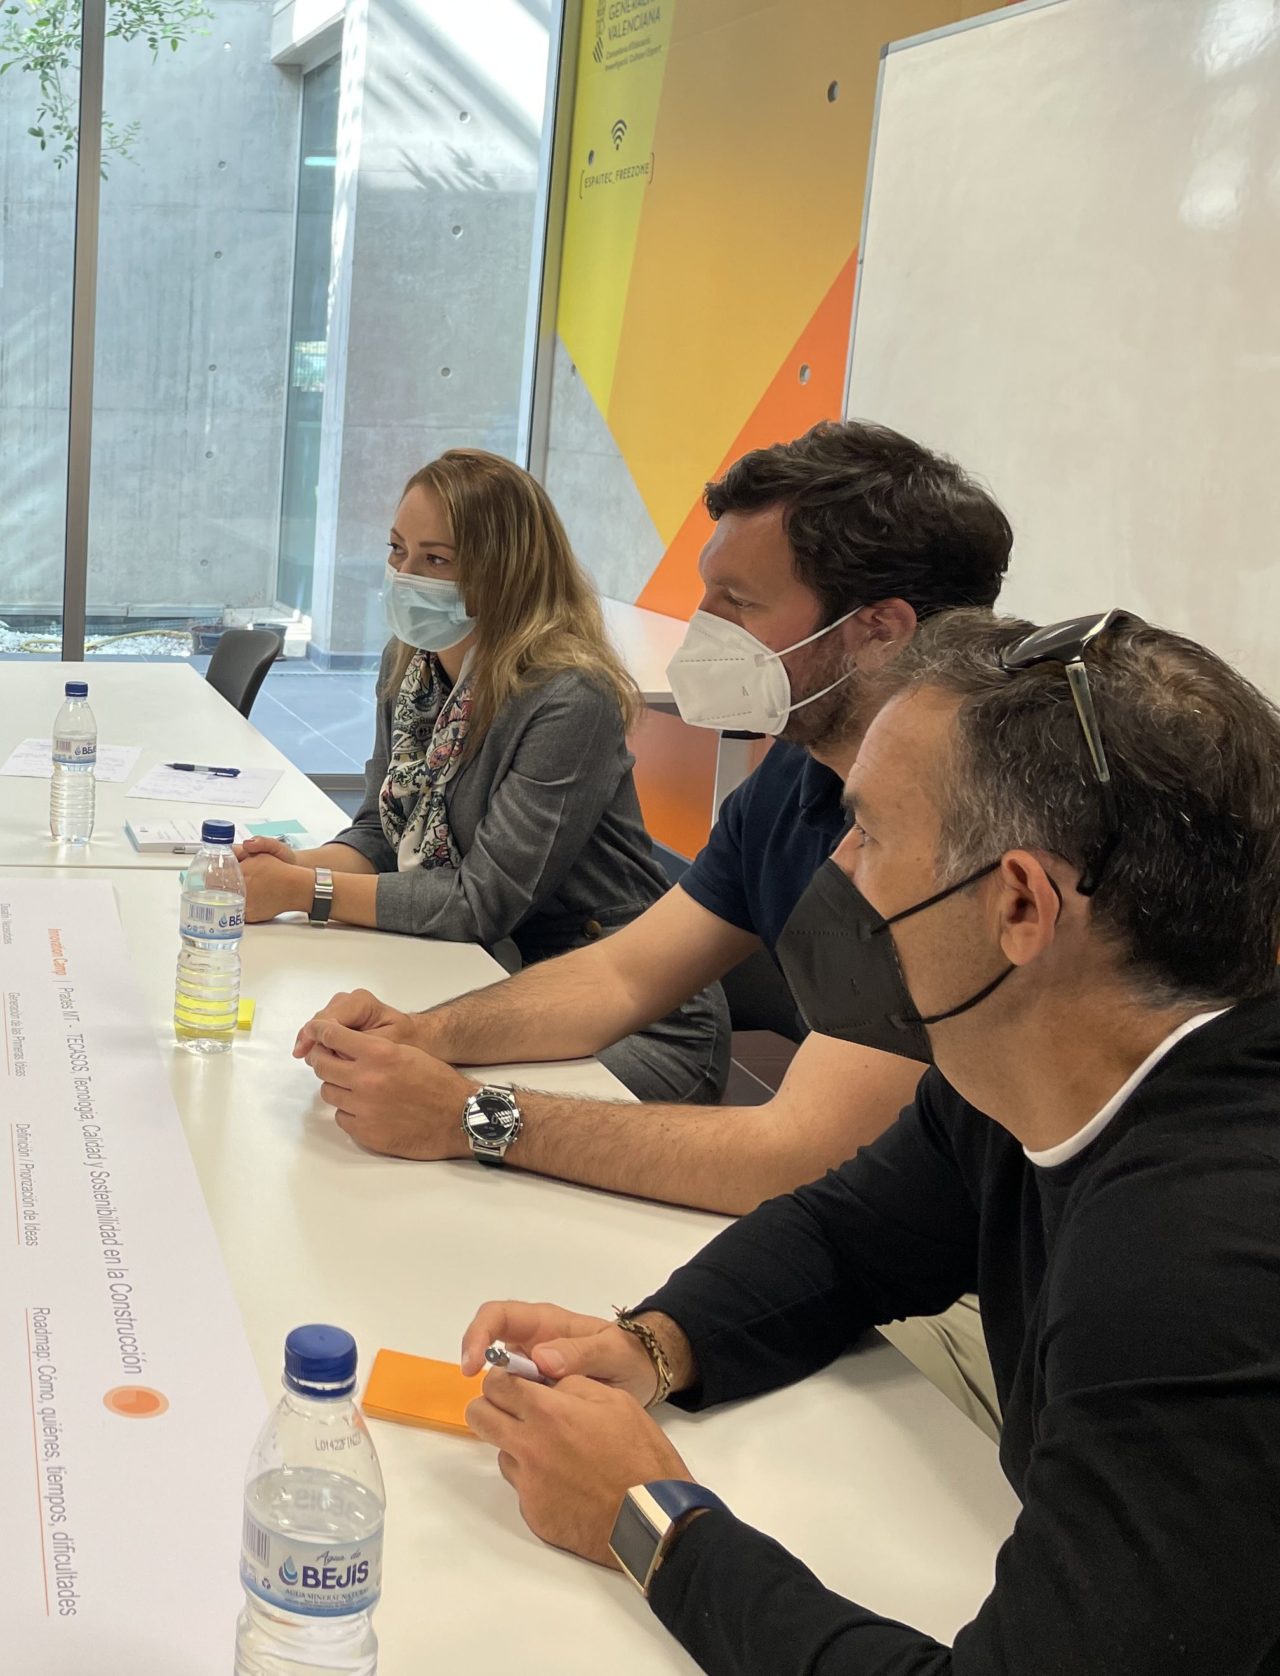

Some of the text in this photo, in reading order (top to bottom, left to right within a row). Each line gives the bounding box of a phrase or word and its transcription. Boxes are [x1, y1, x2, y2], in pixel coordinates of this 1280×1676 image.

[607, 7, 661, 41] VALENCIANA
[48, 928, 65, 957] Innovation
[50, 958, 68, 976] Camp
[58, 987, 75, 1009] Prades
[63, 1011, 80, 1021] MT
[66, 1033, 90, 1074] TECASOS,
[14, 1061, 28, 1077] Ideas
[15, 1123, 32, 1157] Definición
[81, 1124, 106, 1160] Calidad
[83, 1161, 105, 1169] y
[19, 1163, 39, 1208] Priorización
[23, 1209, 39, 1221] de
[90, 1170, 124, 1246] Sostenibilidad
[24, 1223, 41, 1247] Ideas
[103, 1249, 122, 1264] en
[106, 1268, 129, 1279] la
[109, 1283, 147, 1375] Construcción
[31, 1307, 81, 1617] Roadmap: Cómo, quiénes, tiempos, dificultades
